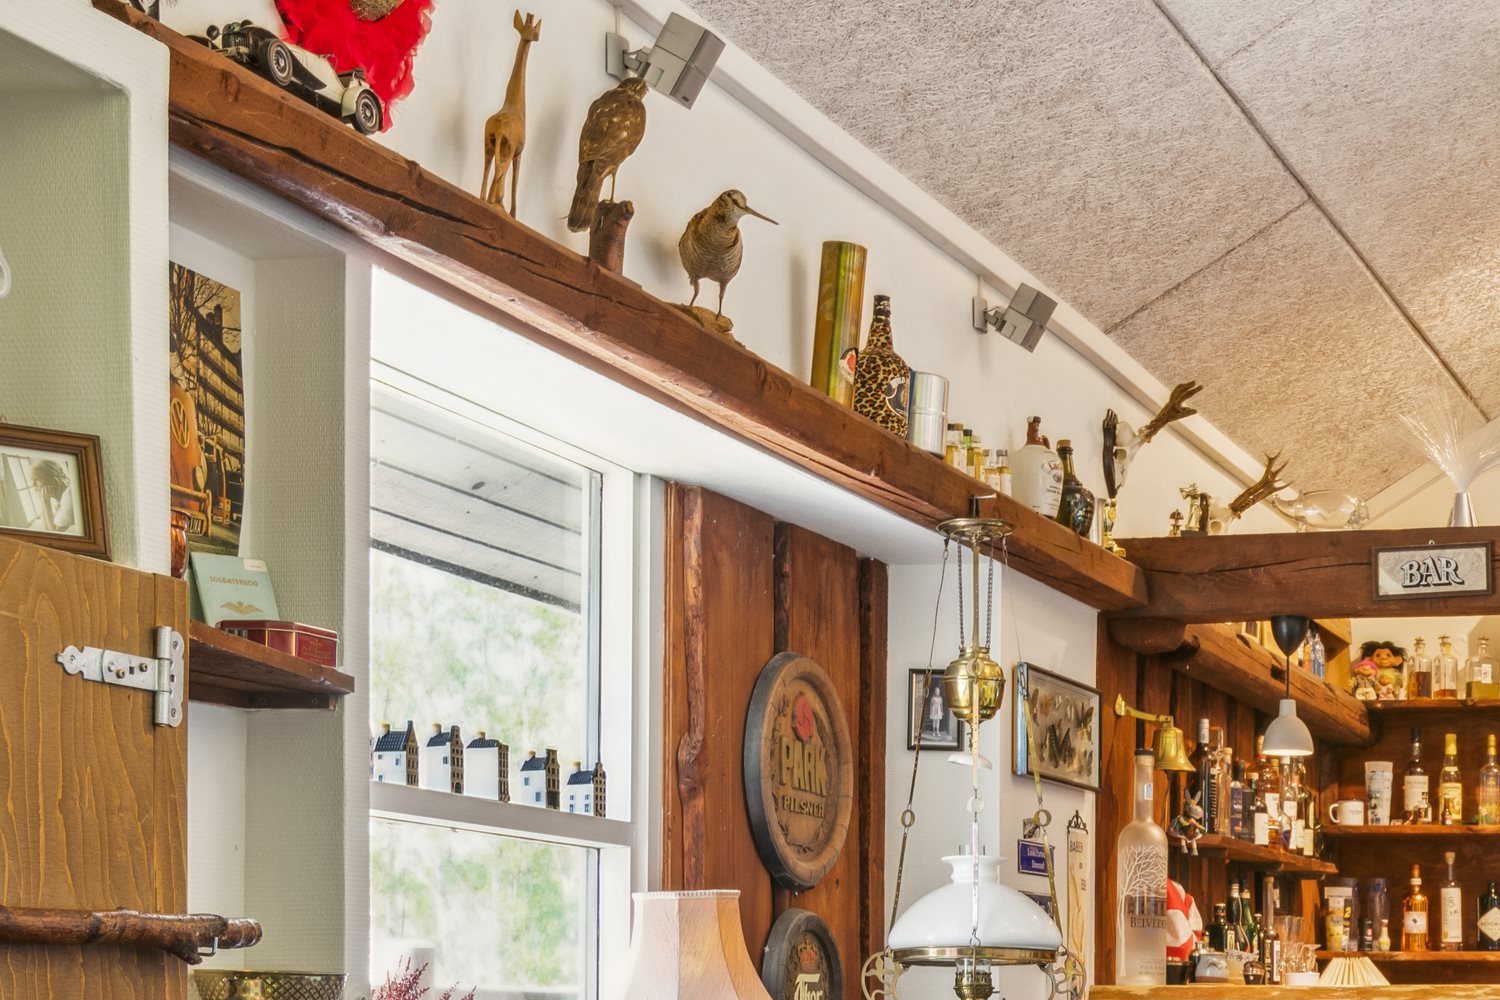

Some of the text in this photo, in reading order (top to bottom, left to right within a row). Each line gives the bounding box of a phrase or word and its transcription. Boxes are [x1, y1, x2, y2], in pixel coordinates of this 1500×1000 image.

[209, 576, 259, 588] SOLDATERBOG
[1401, 556, 1465, 588] BAR
[779, 735, 827, 798] PARK
[782, 795, 825, 819] PILSNER
